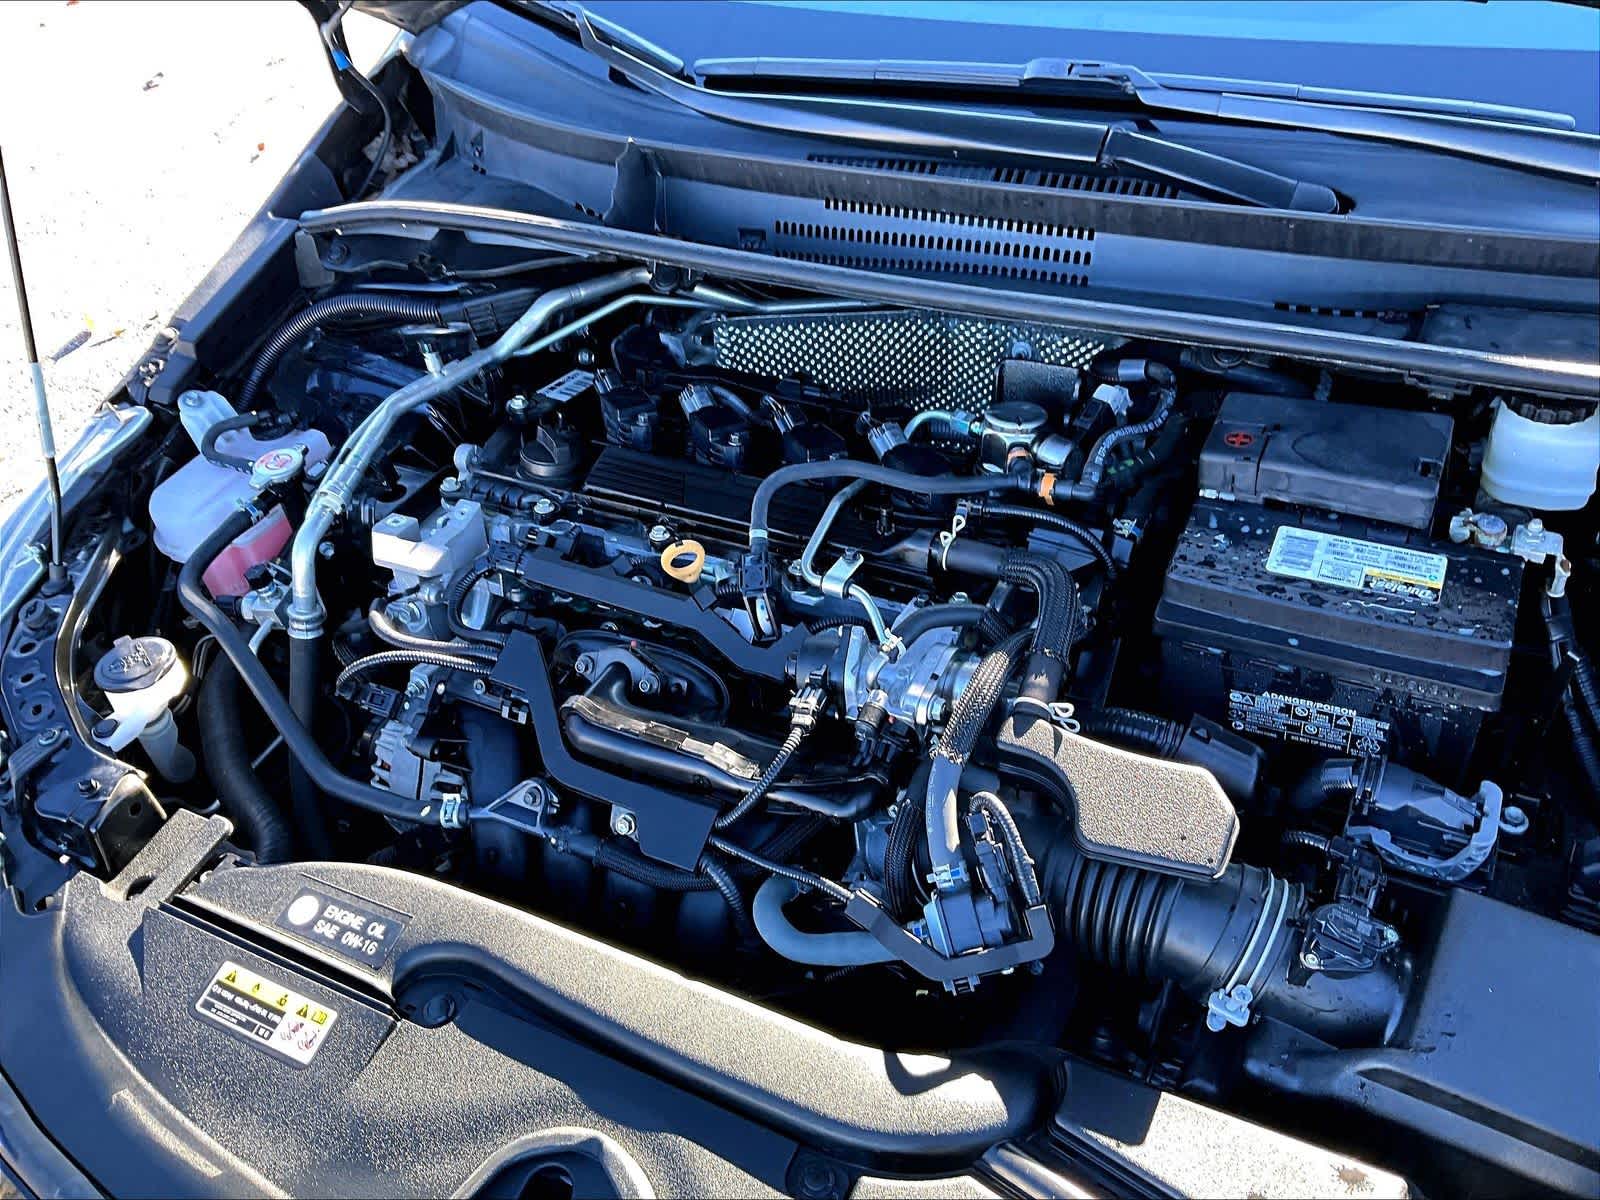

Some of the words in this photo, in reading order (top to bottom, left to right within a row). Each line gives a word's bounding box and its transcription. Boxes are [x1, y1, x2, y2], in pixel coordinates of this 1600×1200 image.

[1369, 577, 1437, 600] Duralast
[1270, 692, 1357, 716] DANGER/POISON
[323, 904, 367, 931] ENGINE
[367, 921, 386, 940] OIL
[313, 919, 340, 940] SAE
[341, 930, 378, 956] 0W-16
